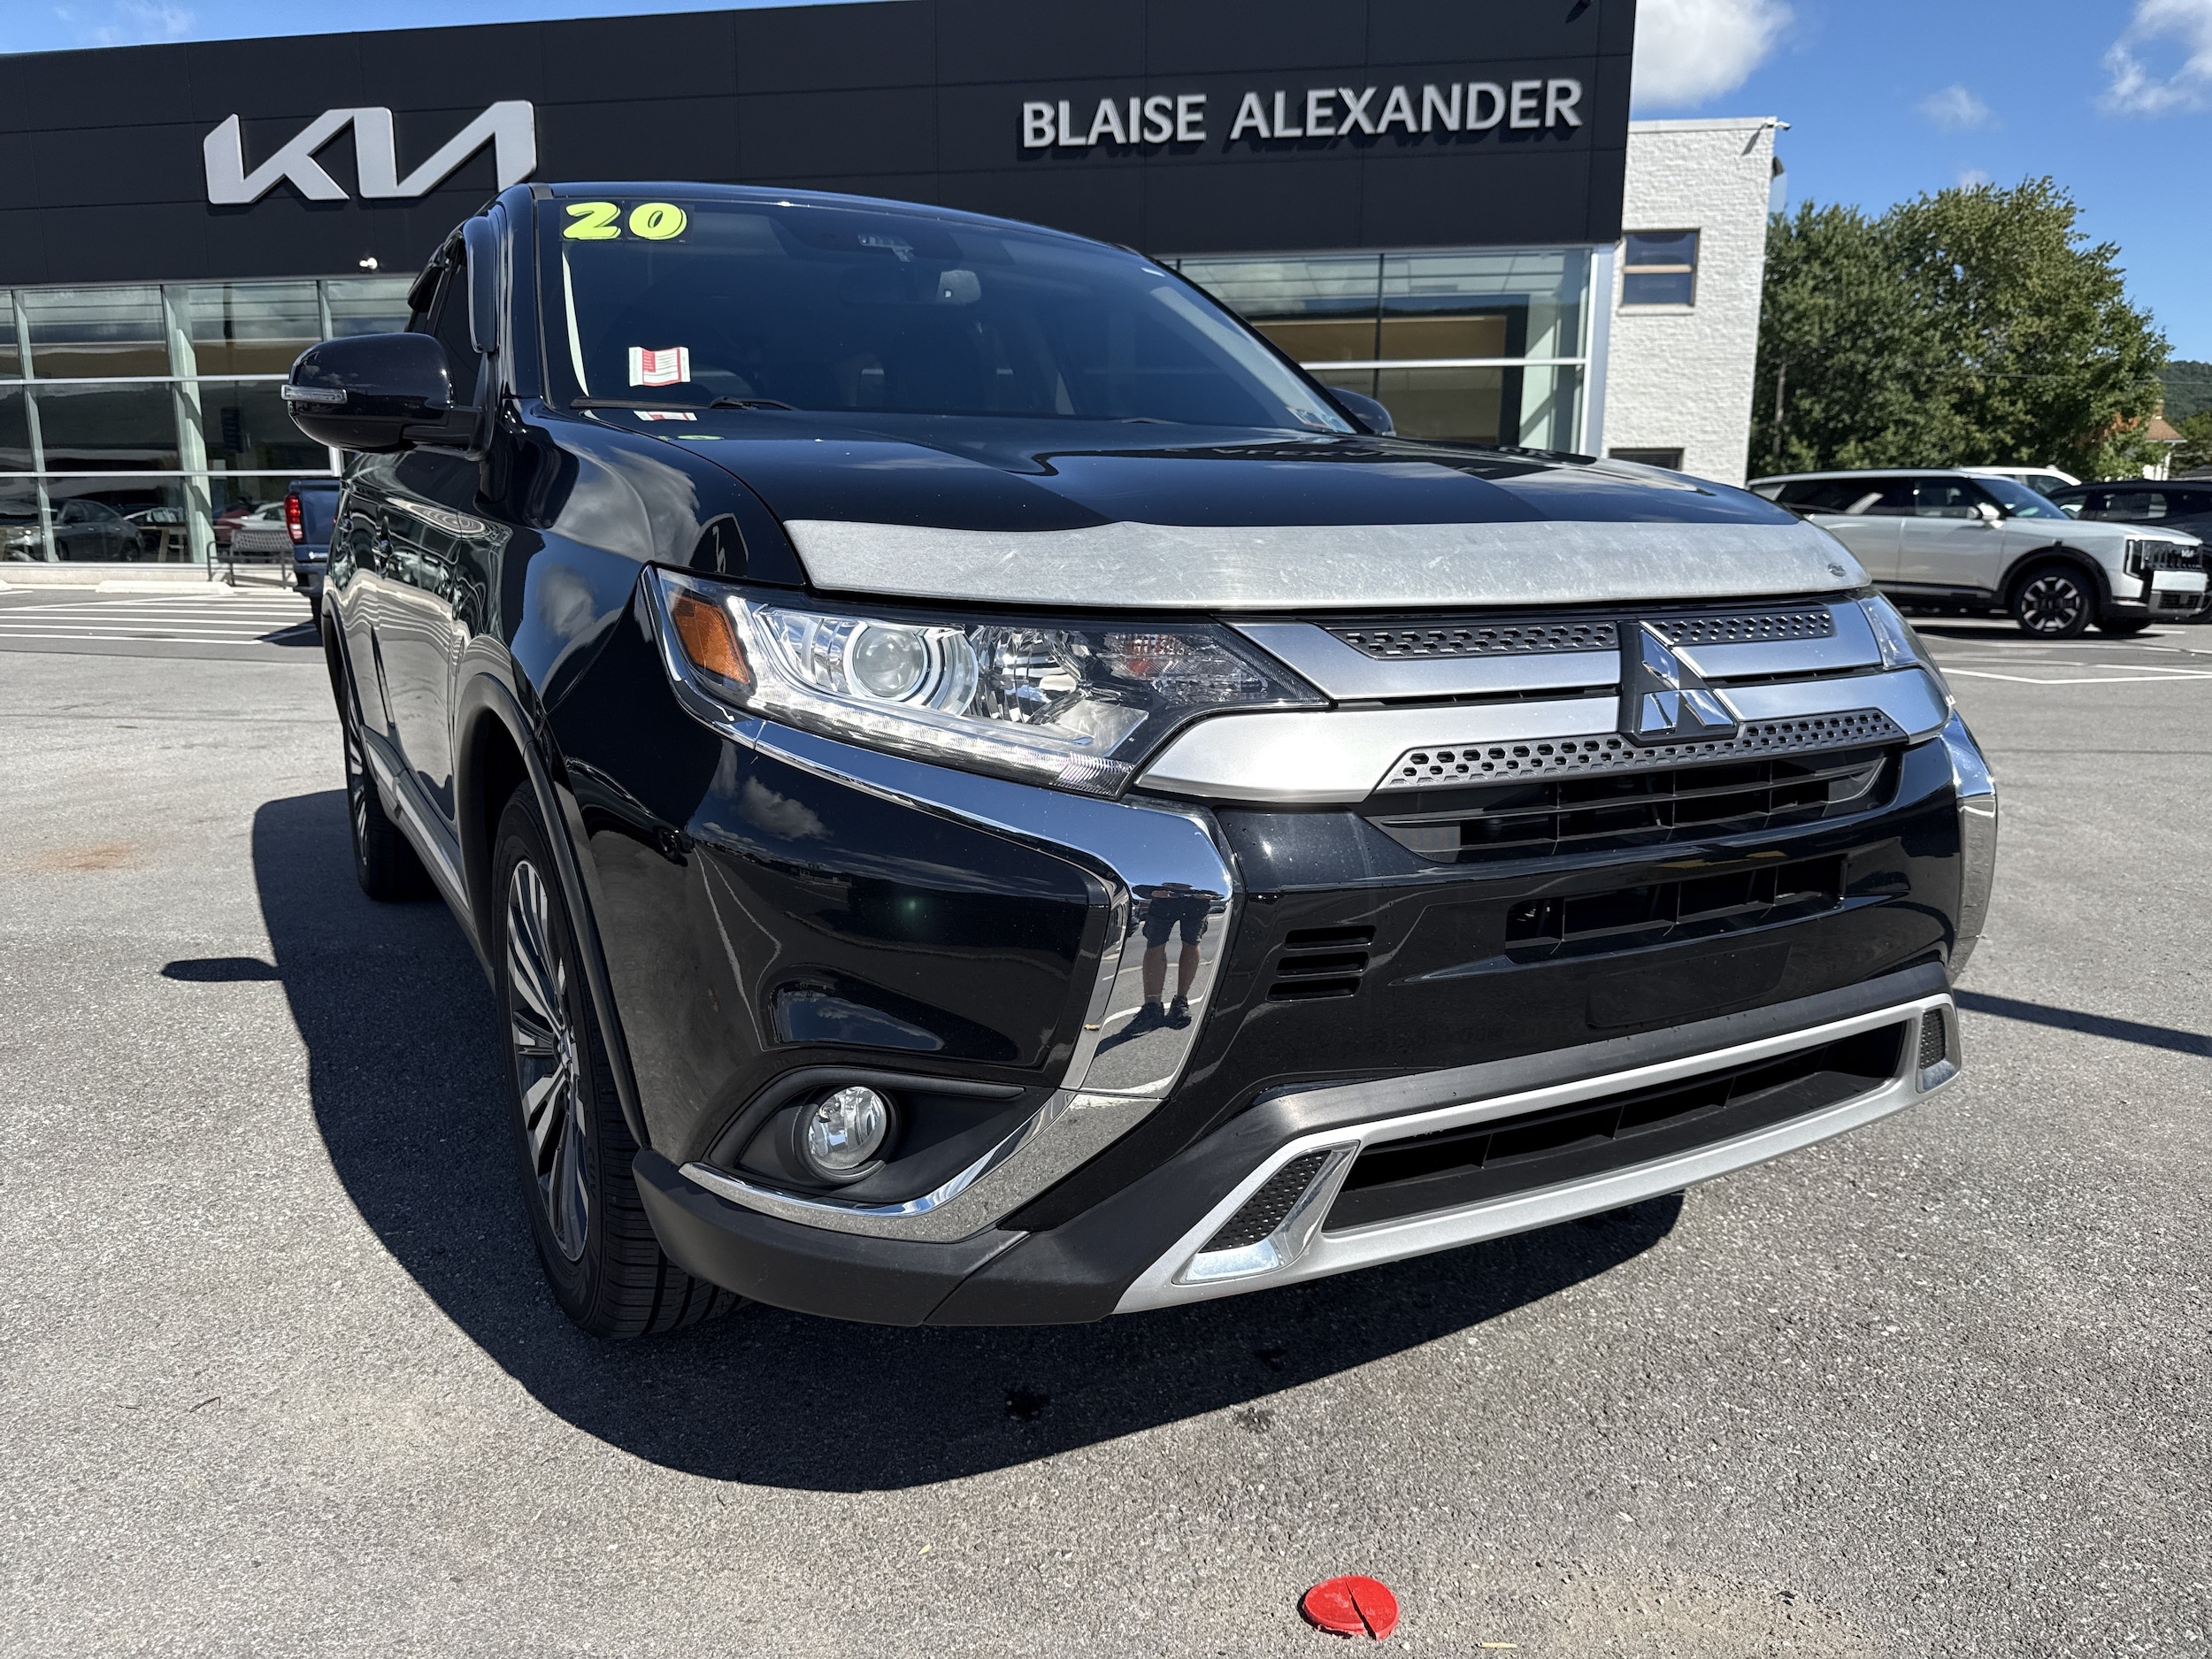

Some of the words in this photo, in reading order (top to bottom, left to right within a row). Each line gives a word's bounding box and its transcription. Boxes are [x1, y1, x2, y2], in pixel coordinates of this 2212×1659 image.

[1023, 93, 1207, 148] BLAISE
[1230, 77, 1583, 140] ALEXANDER
[204, 99, 537, 204] KIA
[563, 201, 687, 241] 20
